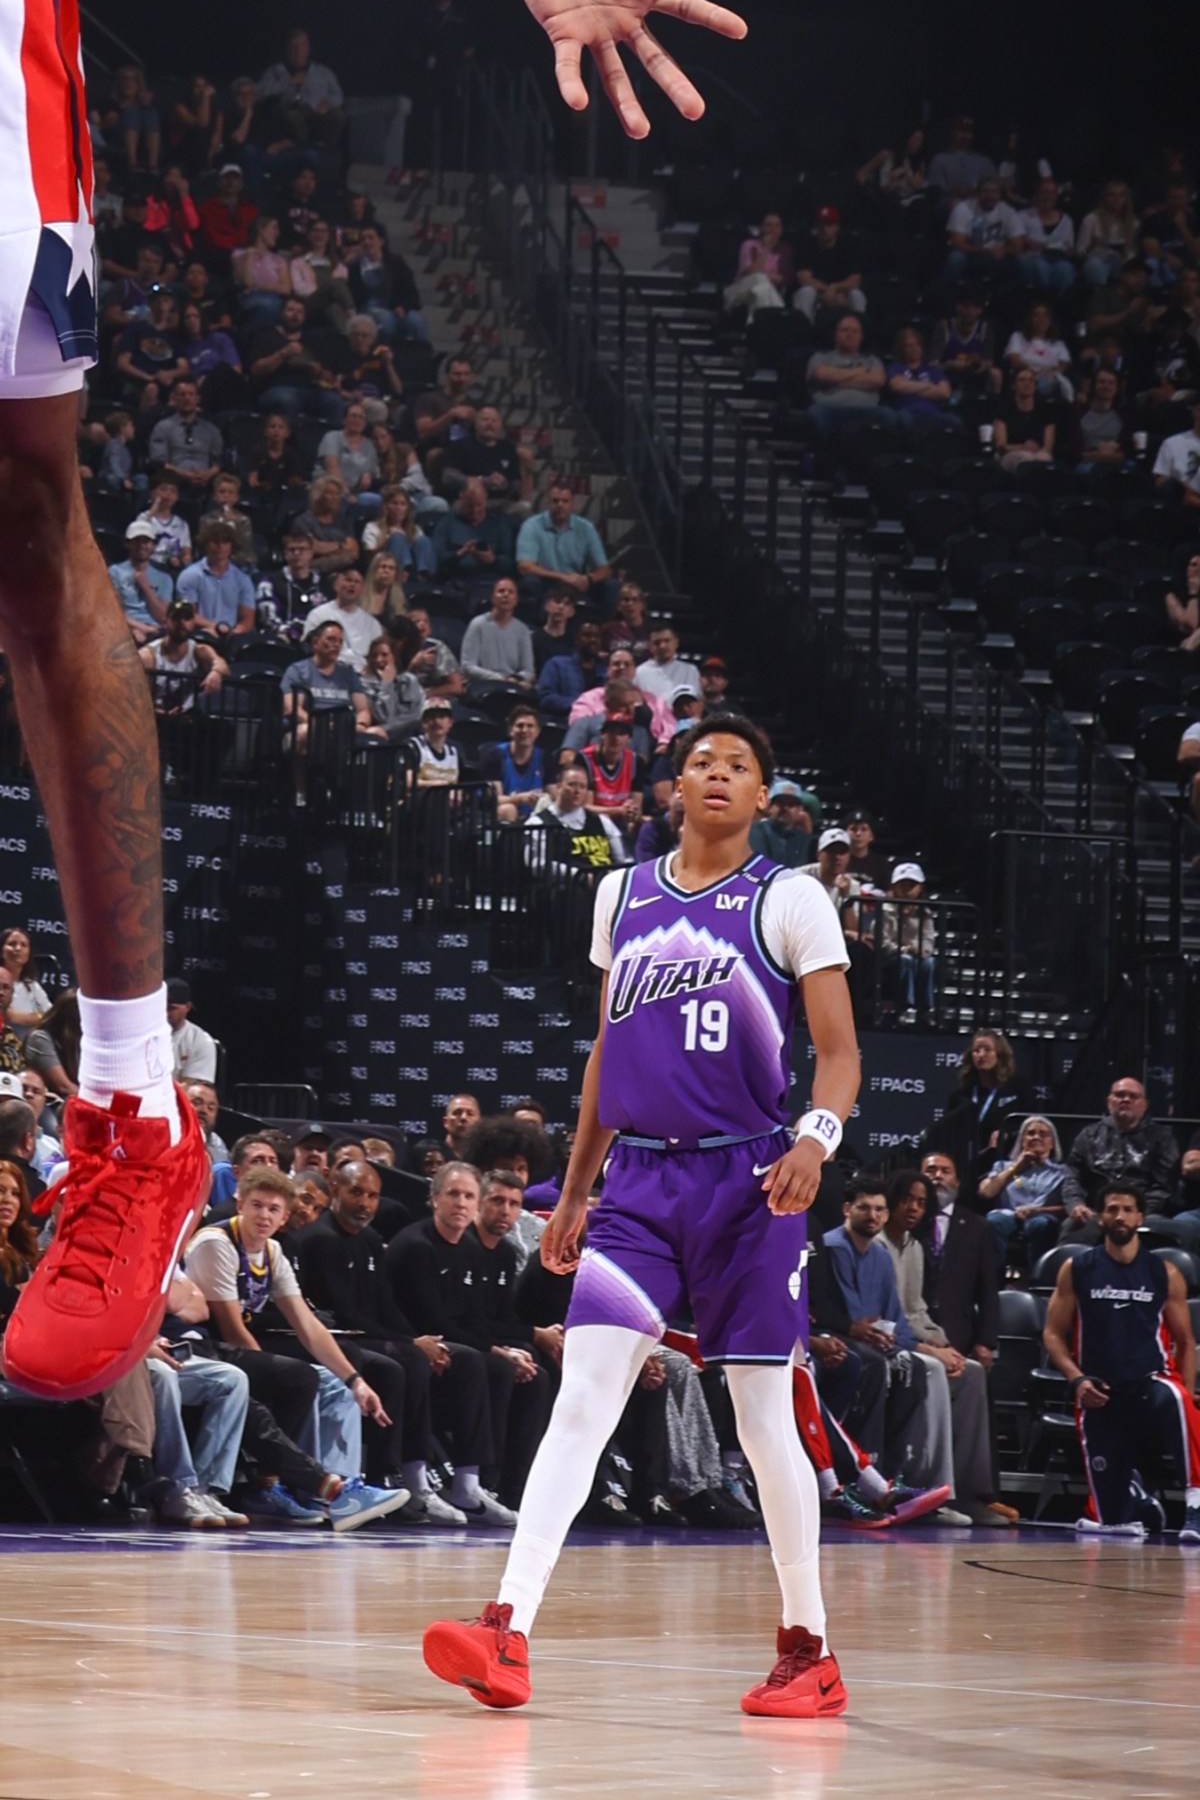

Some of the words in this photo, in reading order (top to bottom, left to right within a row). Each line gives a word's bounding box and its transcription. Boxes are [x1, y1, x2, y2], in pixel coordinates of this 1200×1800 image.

[199, 805, 232, 821] PACS
[715, 893, 750, 911] LVT
[608, 952, 745, 1023] UTAH
[680, 999, 729, 1052] 19
[945, 1053, 964, 1067] PA
[881, 1077, 926, 1093] PACS
[813, 1115, 837, 1140] 19
[1090, 1284, 1154, 1302] wizards
